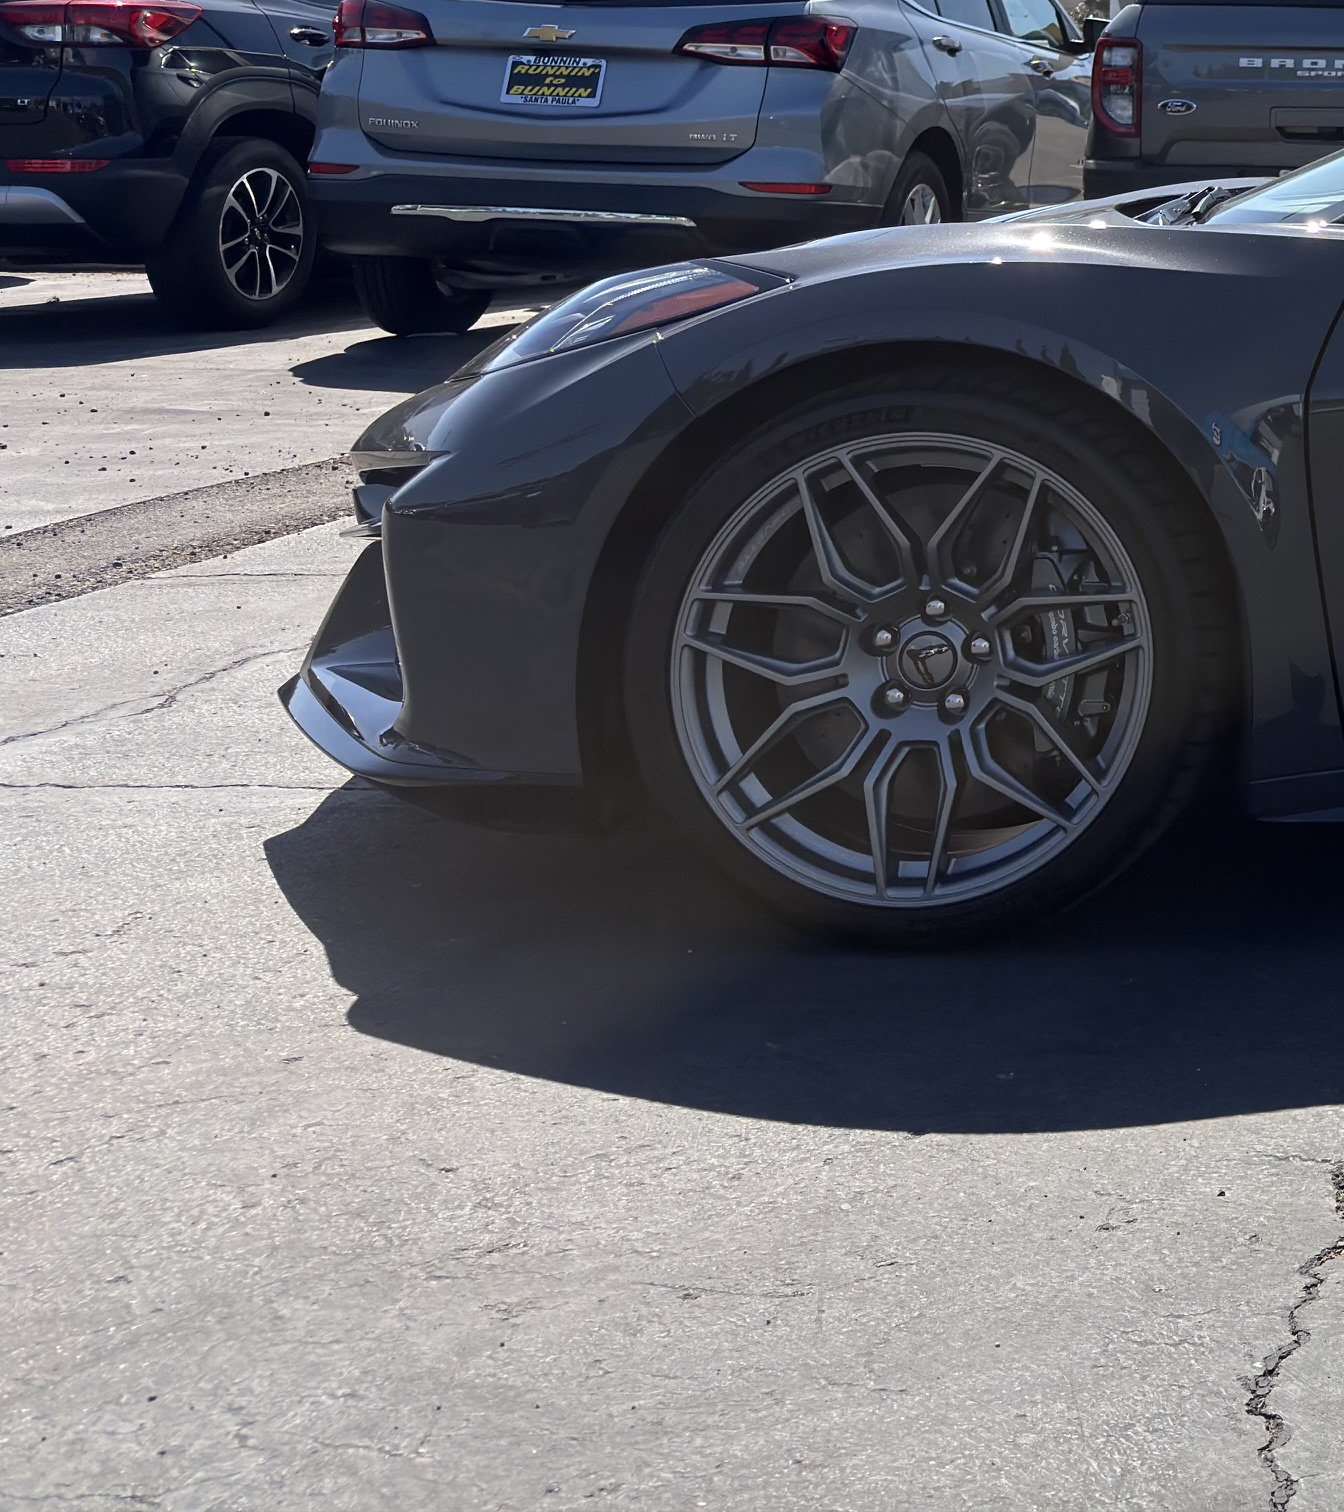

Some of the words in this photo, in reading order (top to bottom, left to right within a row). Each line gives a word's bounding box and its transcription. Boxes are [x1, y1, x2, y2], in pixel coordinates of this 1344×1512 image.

[533, 56, 581, 66] BUNNIN
[544, 76, 566, 84] to
[509, 86, 592, 97] BUNNIN
